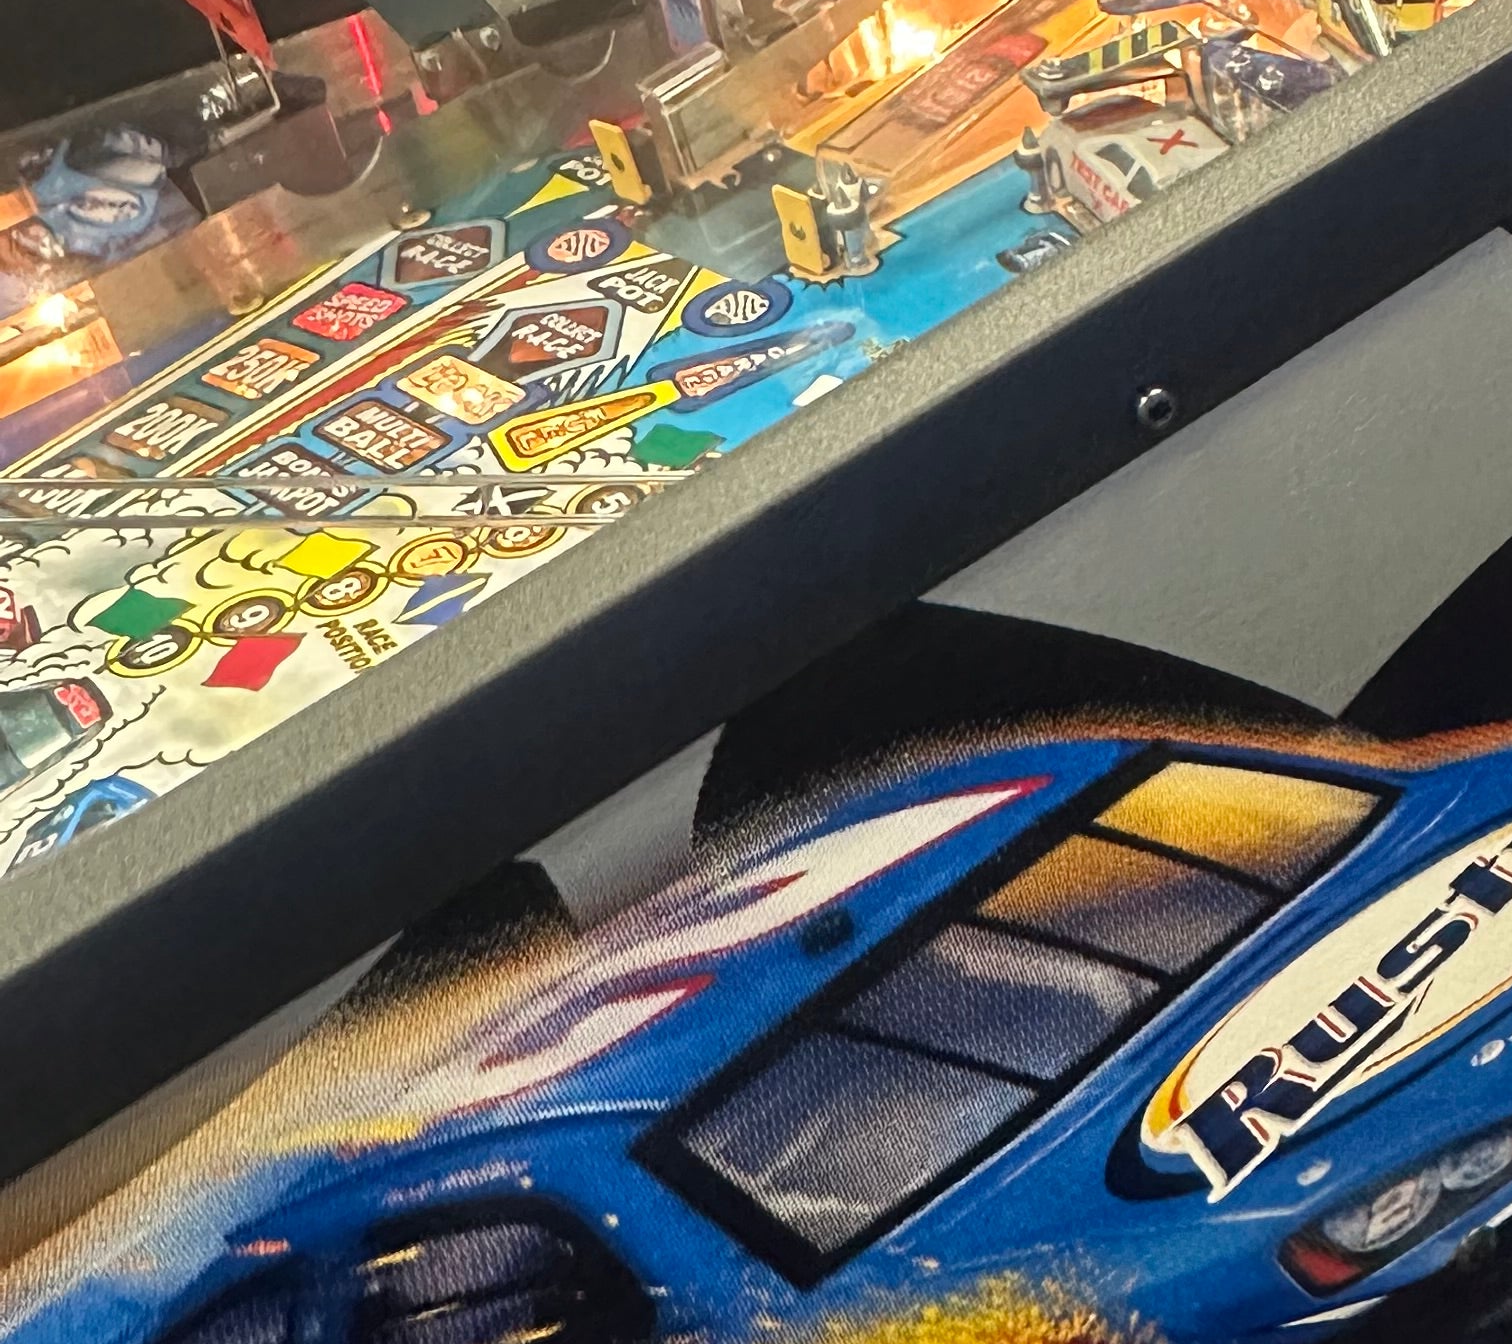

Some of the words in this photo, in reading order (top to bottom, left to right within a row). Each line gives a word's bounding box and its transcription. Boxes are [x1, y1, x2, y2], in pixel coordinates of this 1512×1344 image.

[598, 276, 664, 308] POT
[624, 267, 680, 294] JACK
[511, 323, 585, 359] RACE
[208, 344, 312, 395] 250K
[115, 402, 220, 455] 200K
[324, 416, 411, 470] BALL
[356, 406, 431, 449] MULTI
[592, 492, 632, 515] 5
[321, 576, 362, 602] 8
[229, 603, 270, 630] 9
[315, 618, 373, 675] POSITIO
[353, 618, 399, 656] RACE
